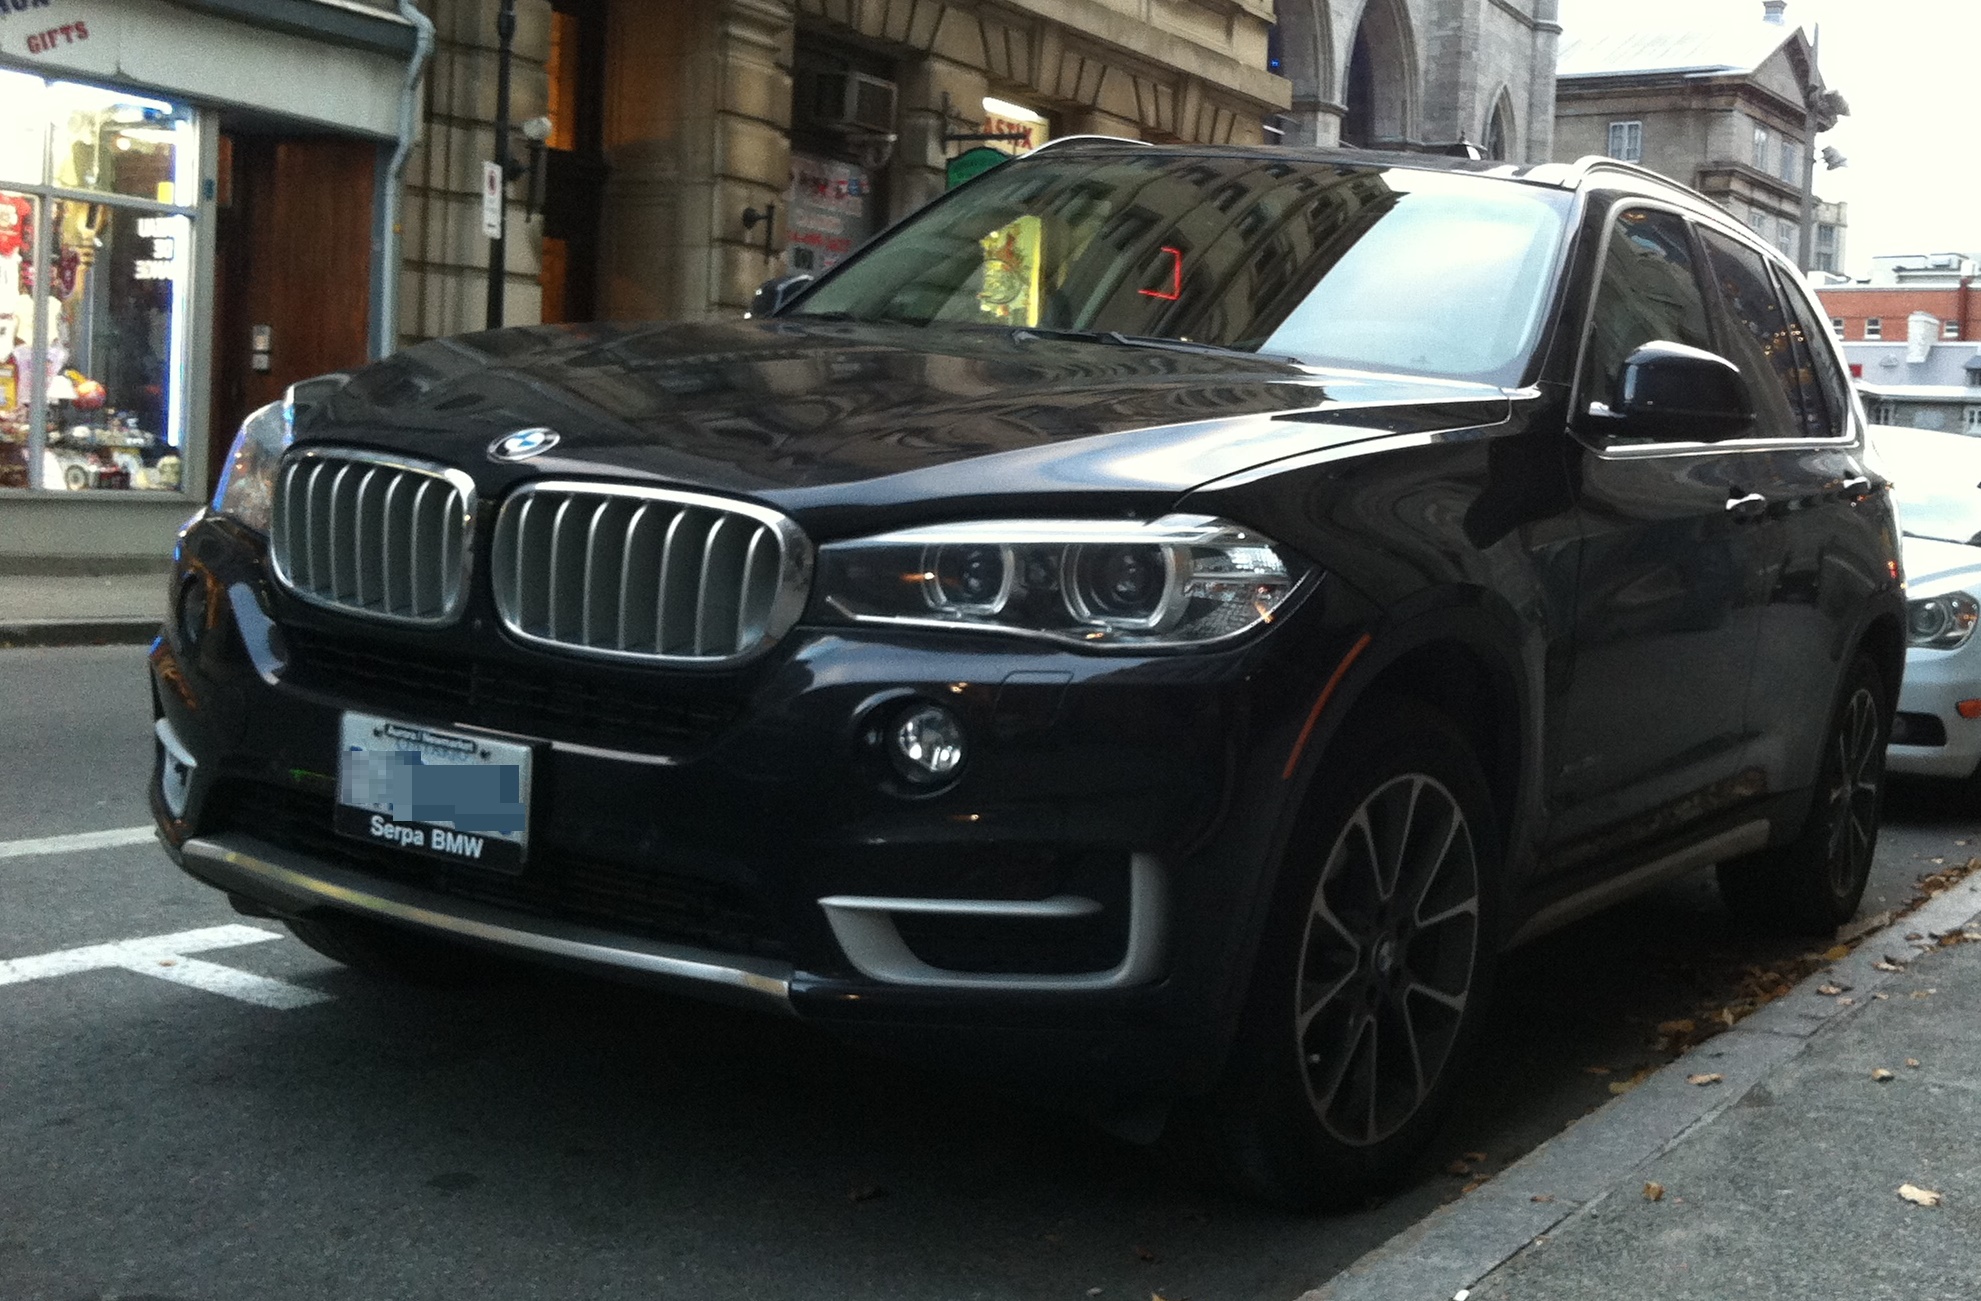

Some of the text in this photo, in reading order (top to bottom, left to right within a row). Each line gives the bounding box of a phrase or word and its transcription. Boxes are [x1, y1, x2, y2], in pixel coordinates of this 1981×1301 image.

[26, 20, 90, 54] GIFTS
[370, 814, 484, 859] Serpa BMW
